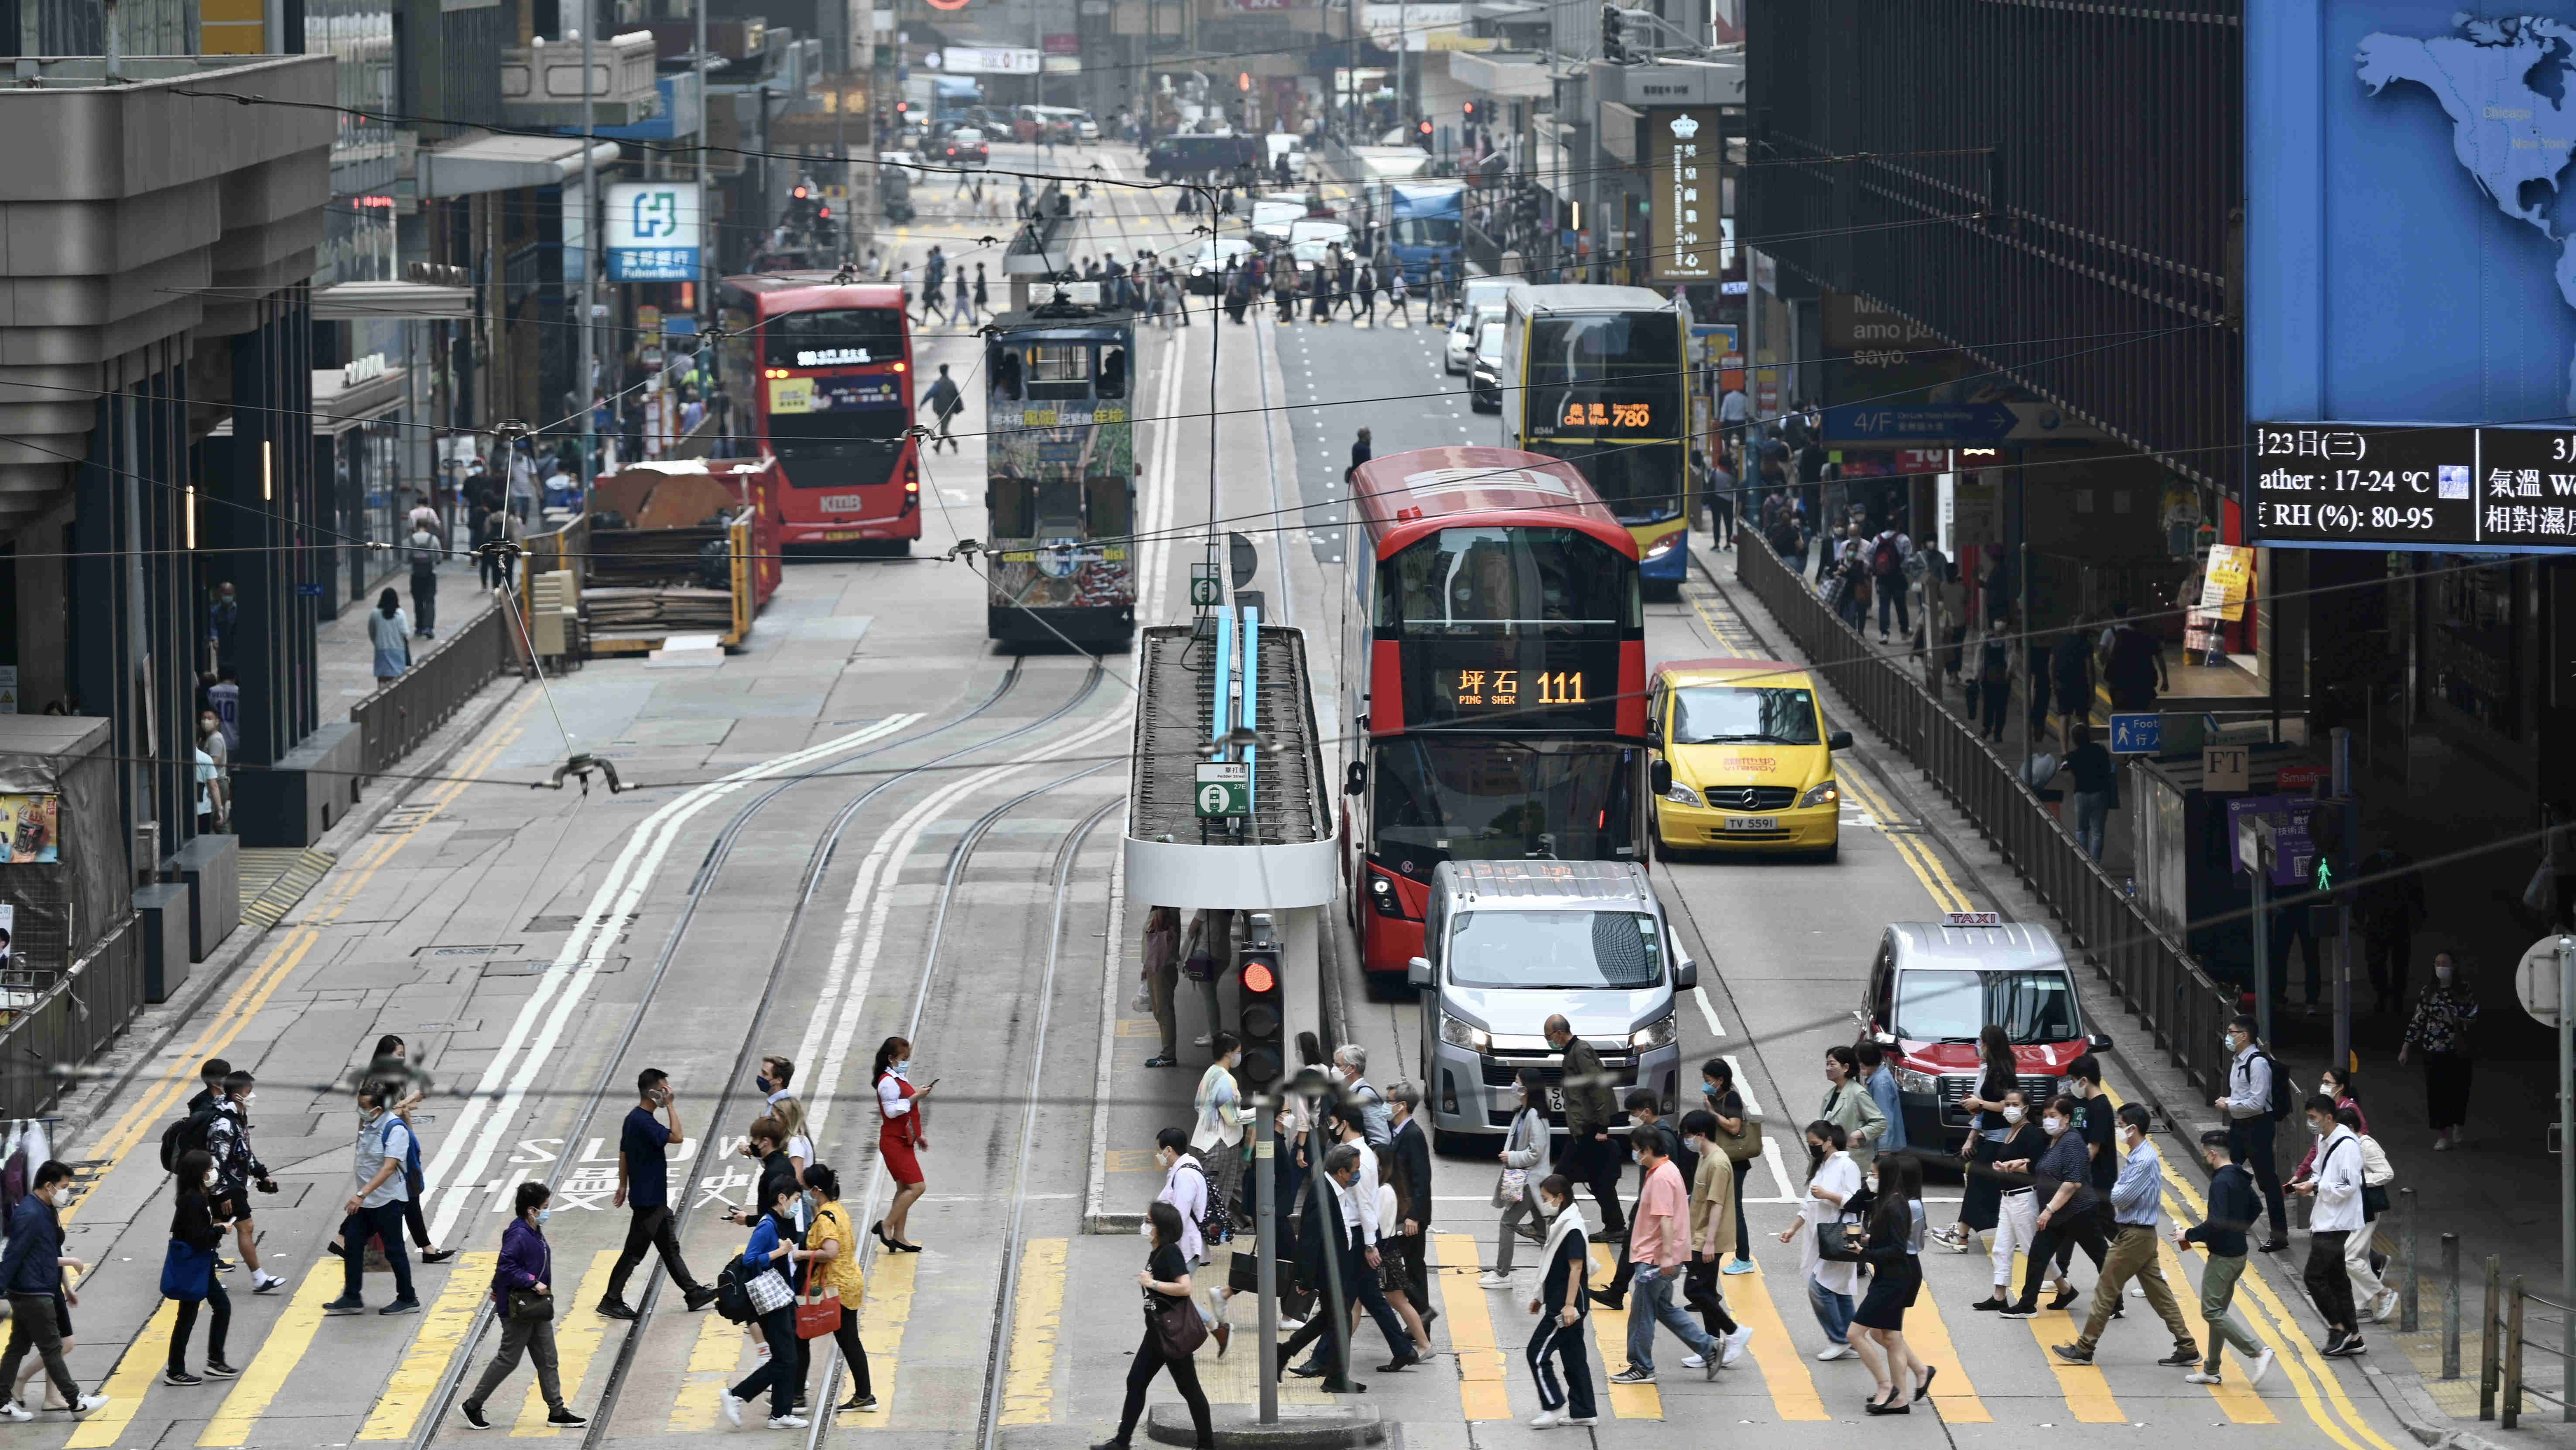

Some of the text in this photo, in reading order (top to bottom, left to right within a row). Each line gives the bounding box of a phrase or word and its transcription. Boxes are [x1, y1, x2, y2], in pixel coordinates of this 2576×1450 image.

[2483, 106, 2532, 121] Chicago
[2512, 137, 2569, 148] New York
[658, 267, 688, 278] Bank
[1854, 324, 1900, 339] amo
[1854, 350, 1909, 369] sayo.
[1564, 410, 1649, 427] Chai Wan 780
[1854, 411, 1892, 432] 4/F
[2260, 467, 2314, 490] ather
[2335, 470, 2396, 492] 17-24
[2488, 467, 2576, 498] 氣溫 W
[820, 494, 862, 513] KMB
[2273, 504, 2312, 526] RH
[2371, 506, 2434, 529] 80-95
[1102, 548, 1126, 561] Risk
[1457, 670, 1585, 703] 坪石 111
[1459, 695, 1516, 704] PING SHEK
[2207, 751, 2246, 774] FT
[1729, 819, 1773, 829] TV 5591
[1950, 913, 1996, 923] TAXI
[1549, 1098, 1565, 1110] 16
